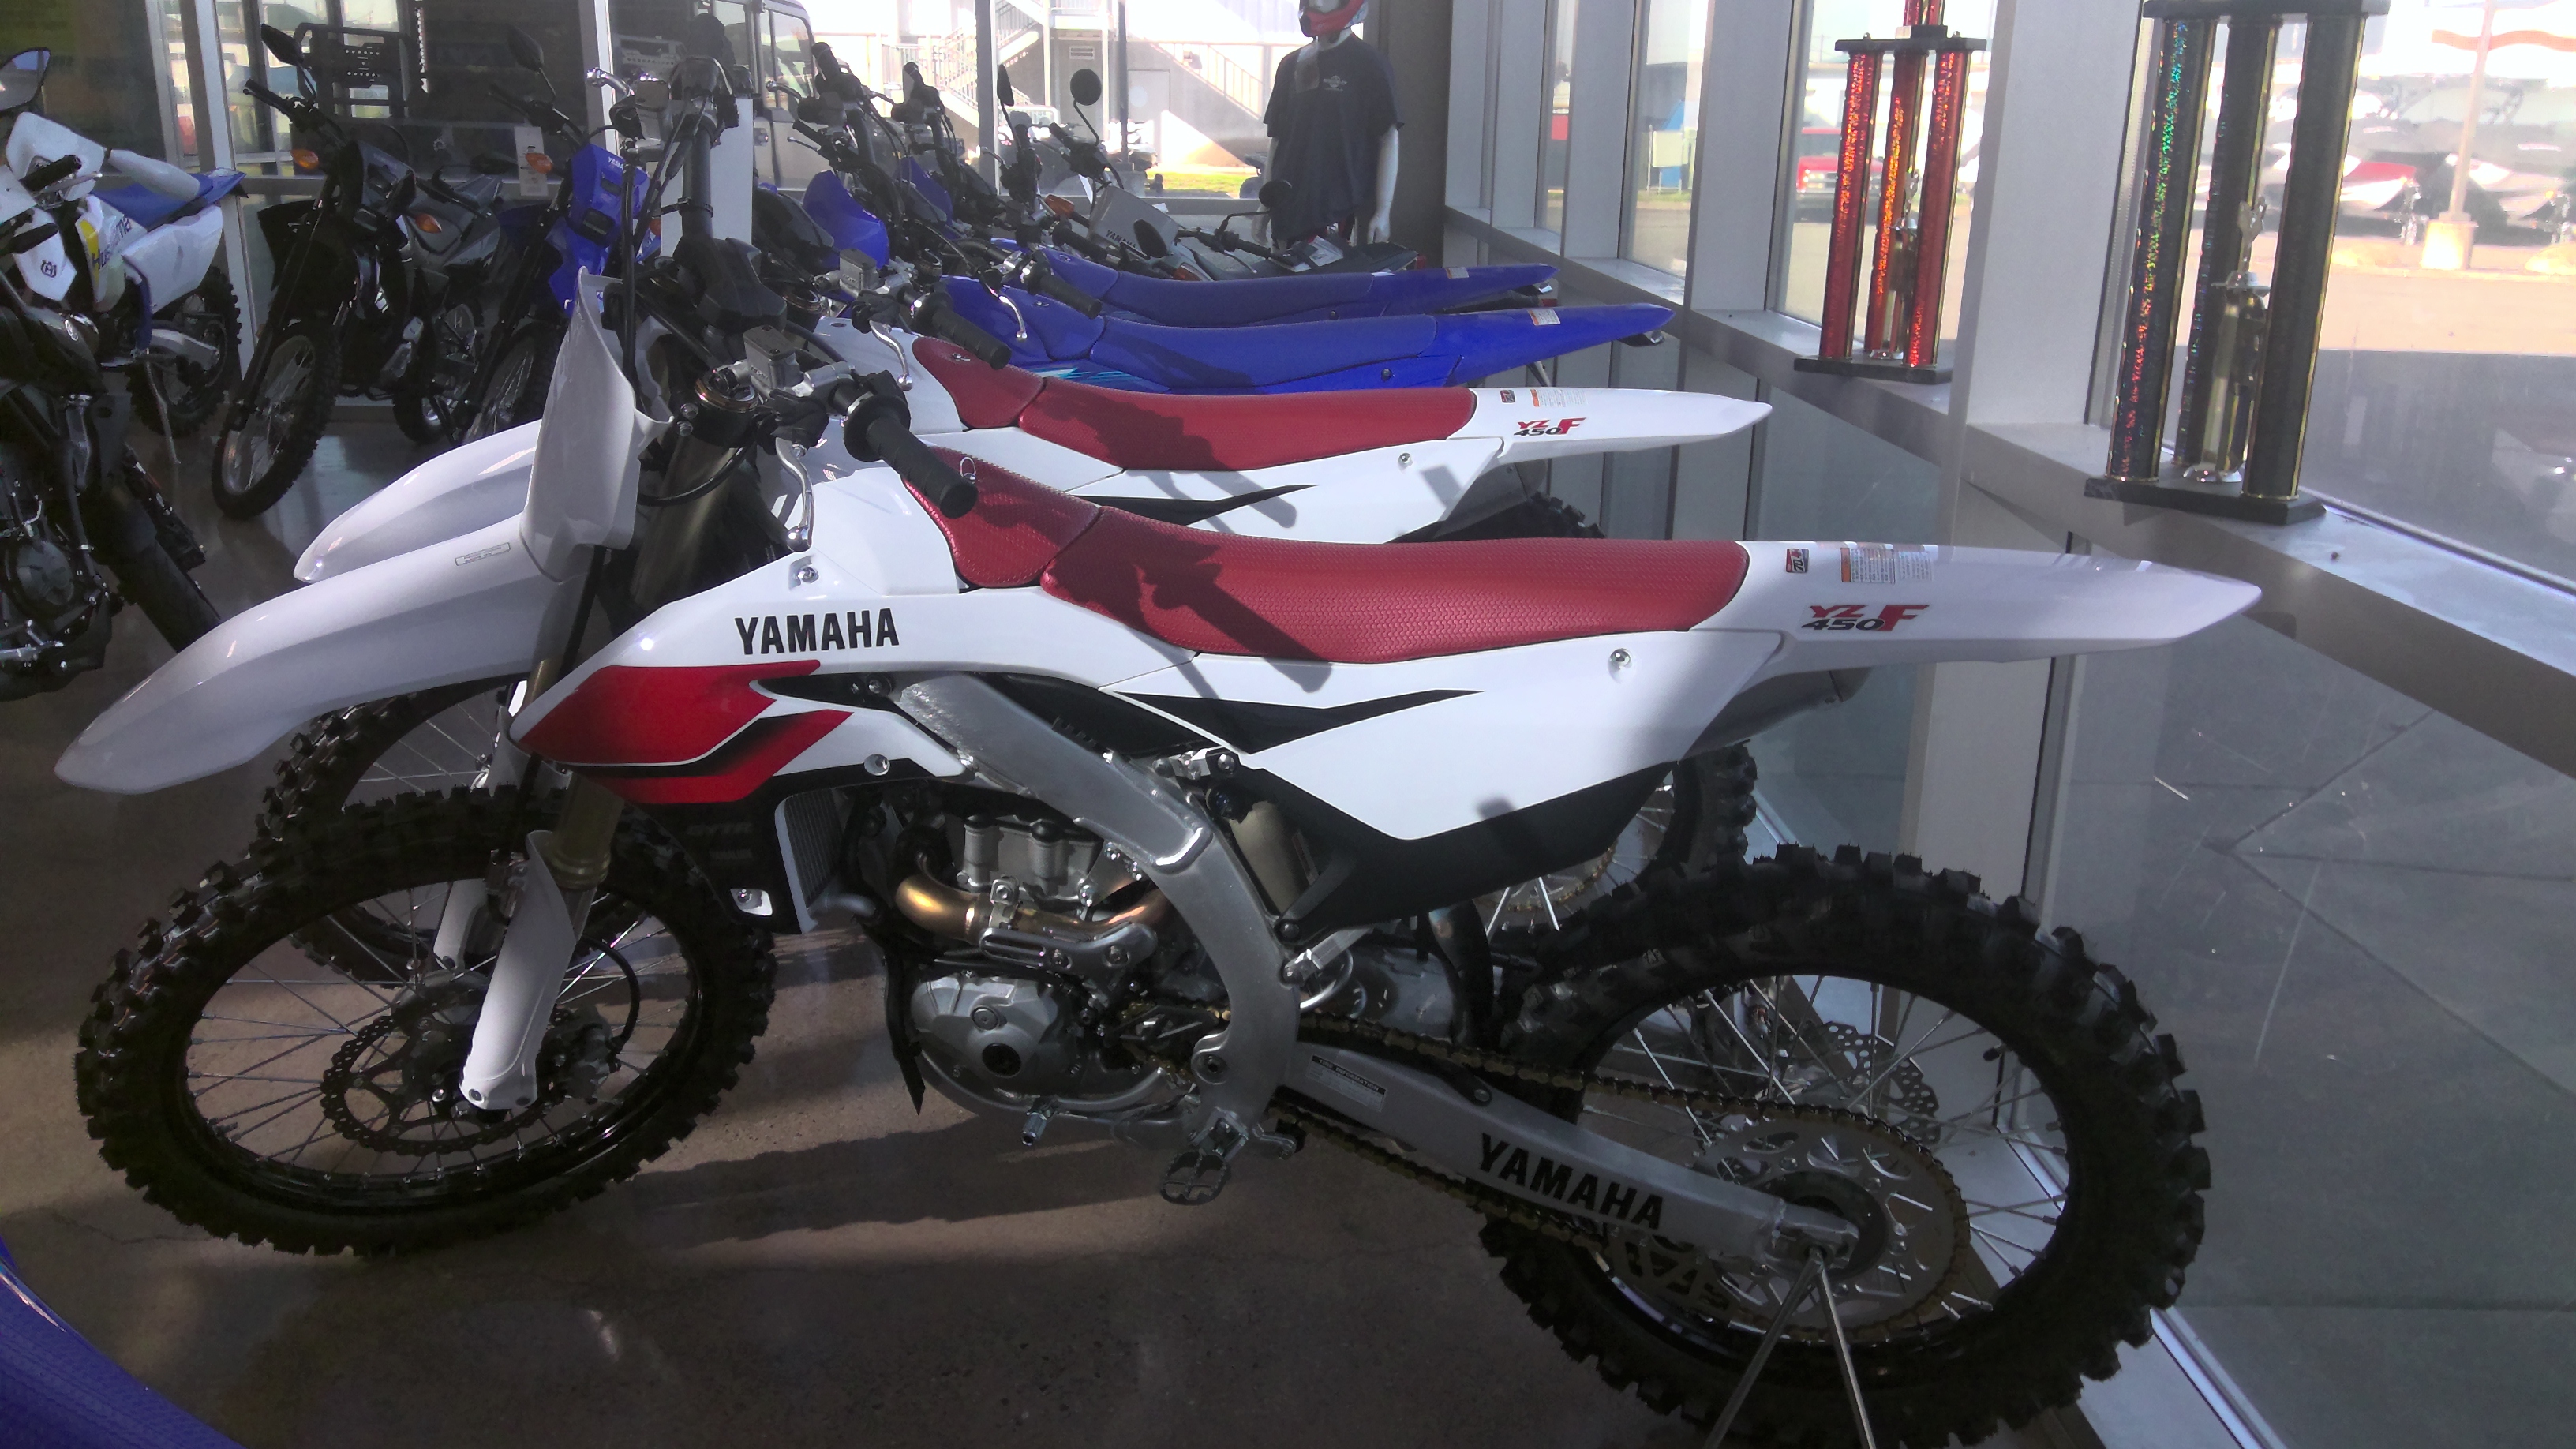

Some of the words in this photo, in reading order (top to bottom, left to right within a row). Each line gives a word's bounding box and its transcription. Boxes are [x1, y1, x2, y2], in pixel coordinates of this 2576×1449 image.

[608, 156, 623, 170] YAMA
[1517, 419, 1550, 429] YZ
[1810, 605, 1868, 618] YZ
[735, 608, 899, 655] YAMAHA
[1479, 1133, 1663, 1229] YAMAHA
